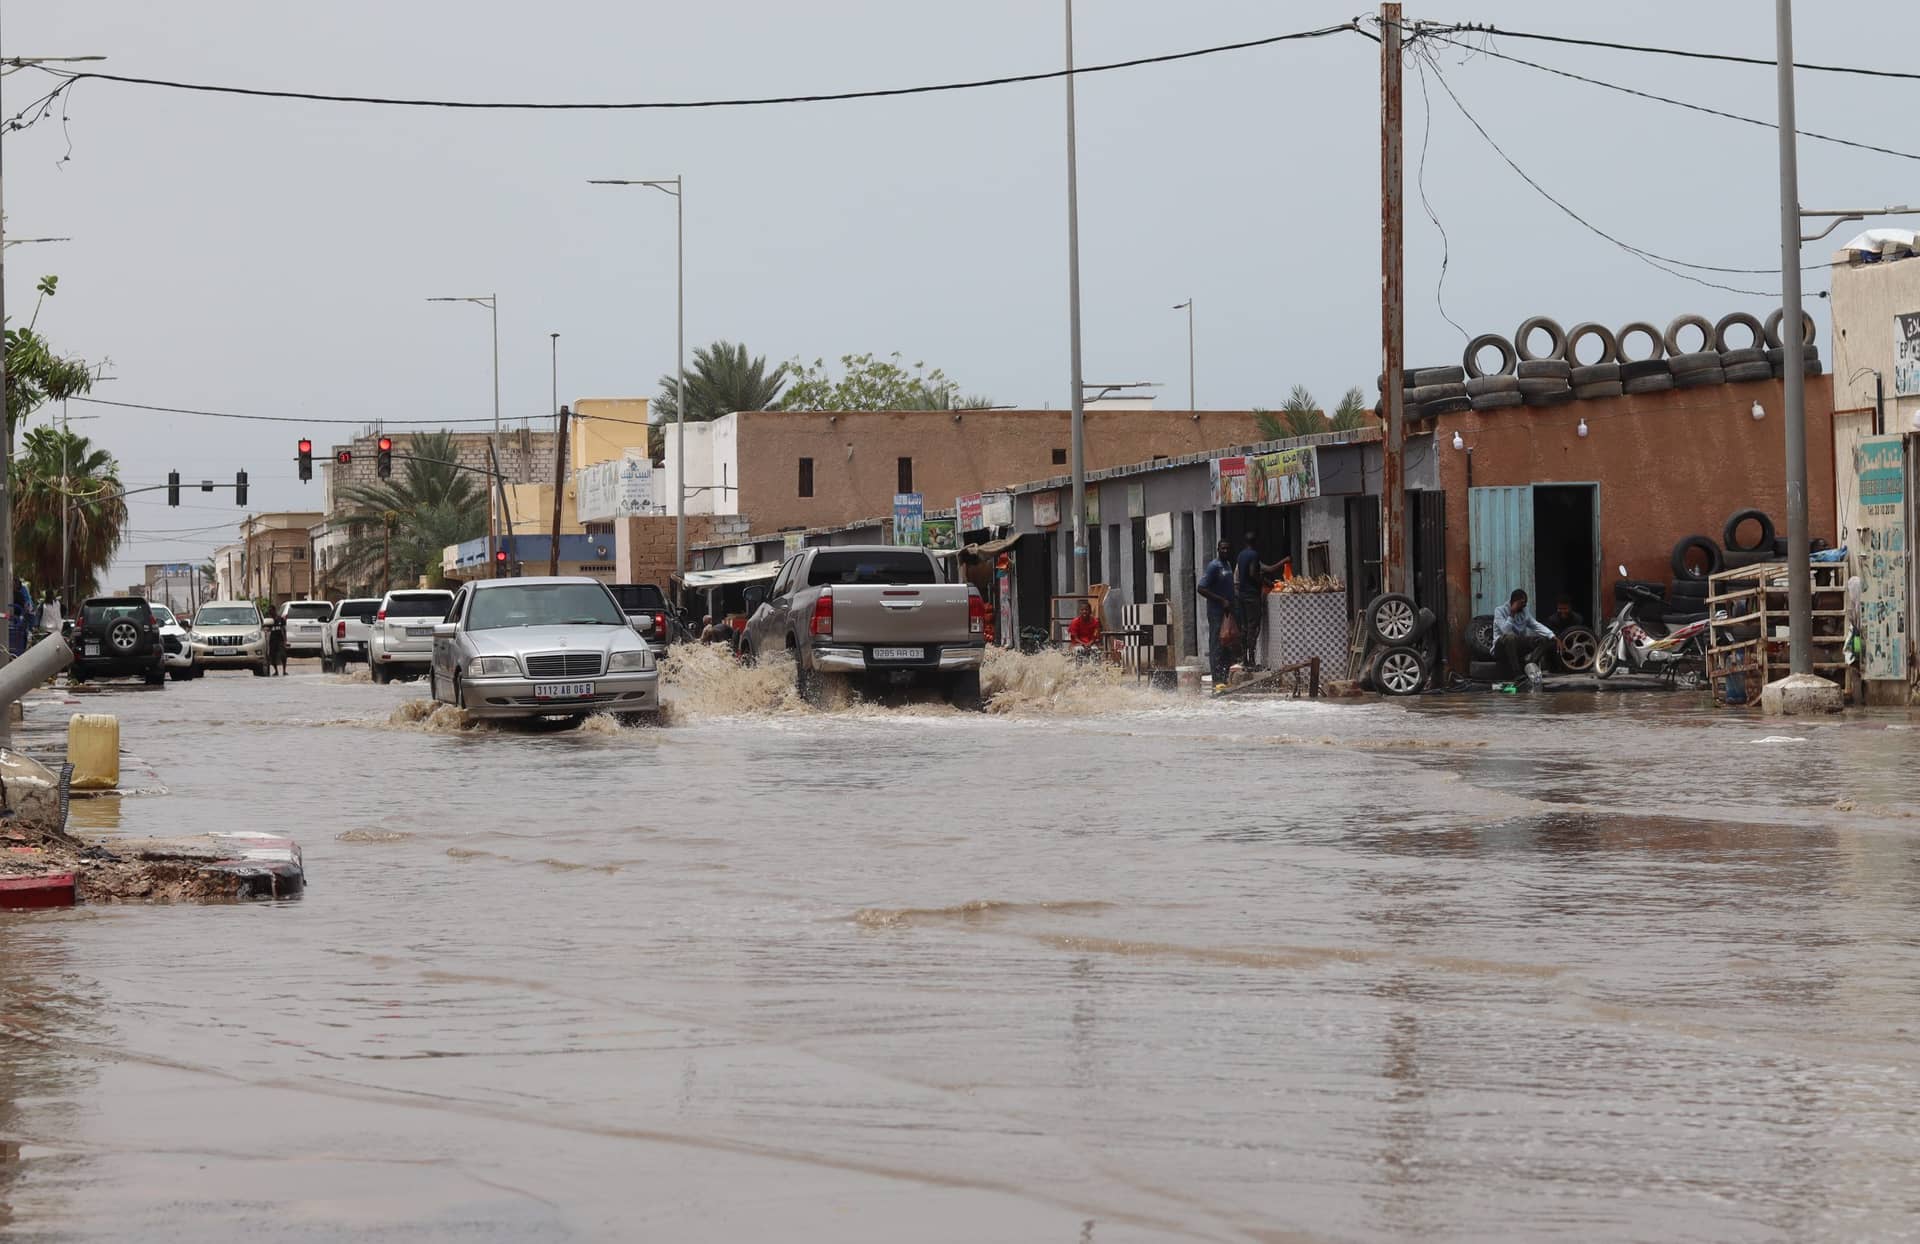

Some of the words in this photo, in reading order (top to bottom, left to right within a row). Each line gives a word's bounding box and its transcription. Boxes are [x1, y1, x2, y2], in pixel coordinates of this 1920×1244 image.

[537, 686, 558, 695] 3112
[561, 685, 571, 694] AB
[574, 684, 584, 694] 06
